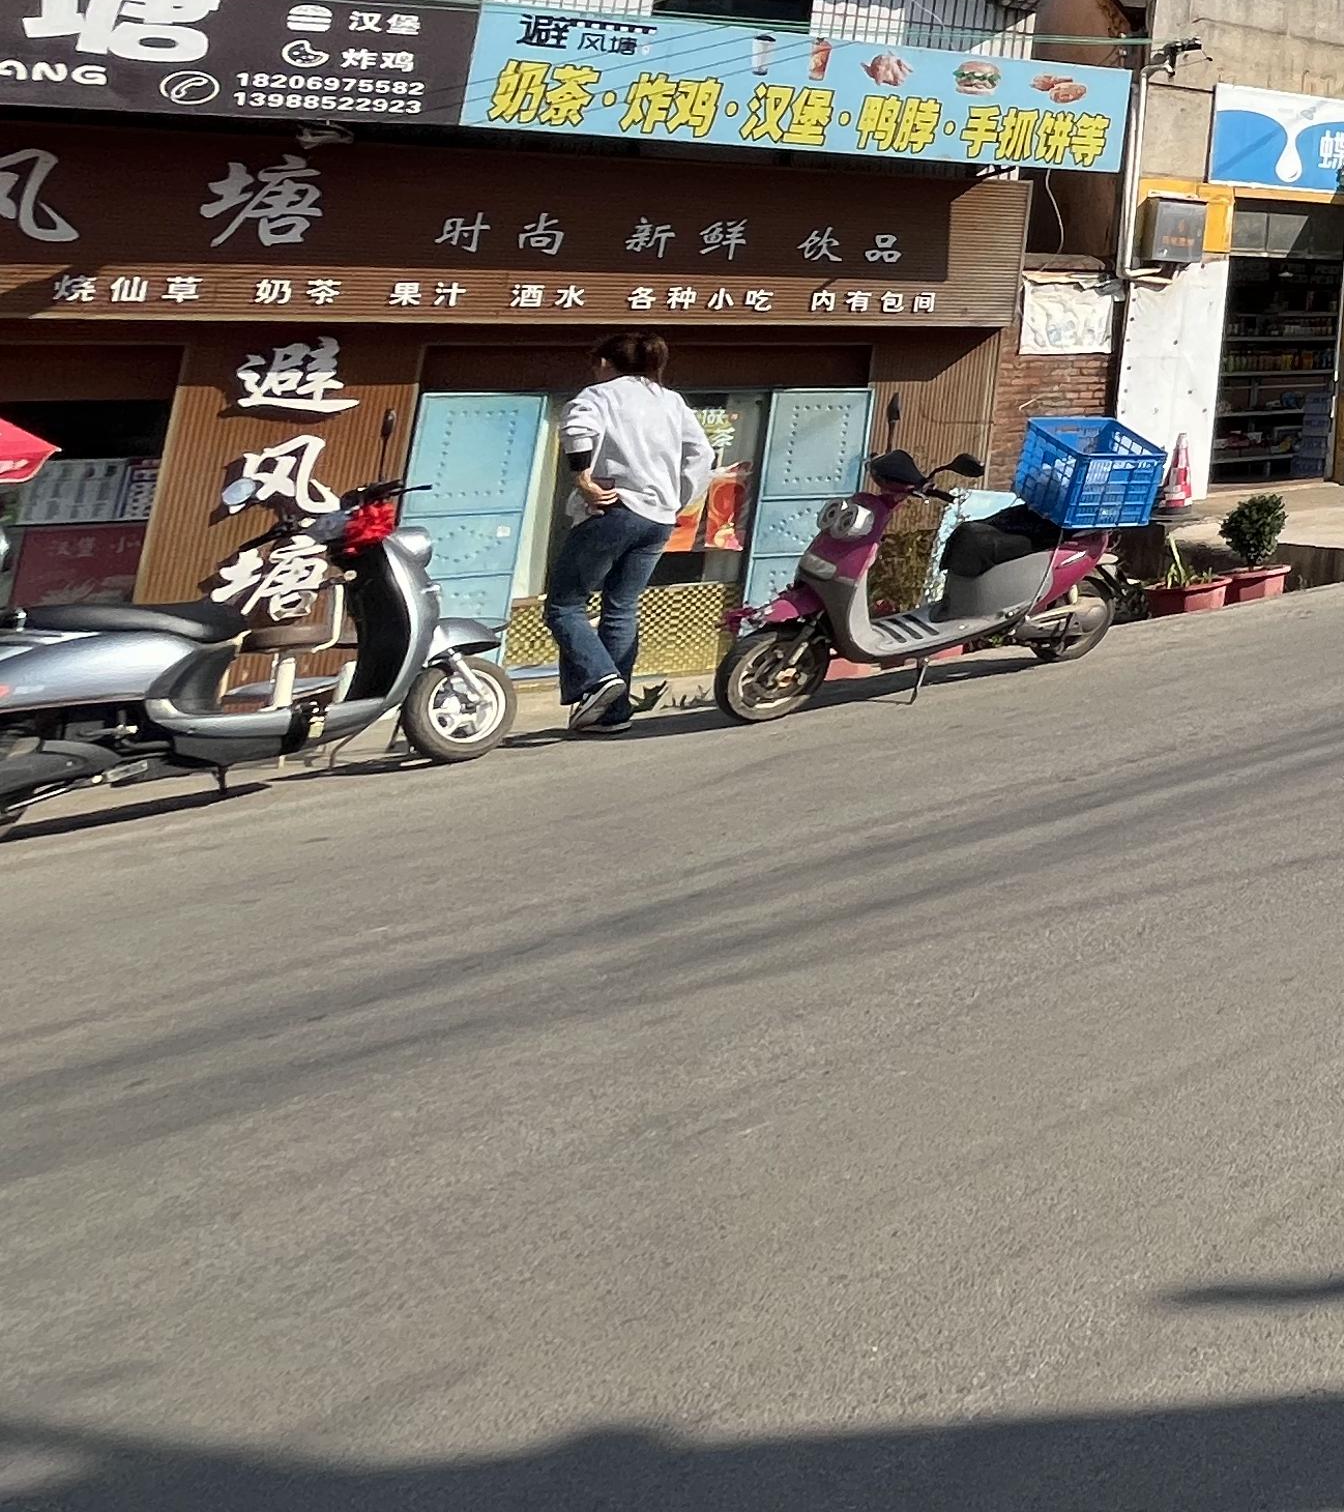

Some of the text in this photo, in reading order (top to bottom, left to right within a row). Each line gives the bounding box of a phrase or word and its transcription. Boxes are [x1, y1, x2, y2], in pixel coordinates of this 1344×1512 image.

[348, 11, 421, 37] 汉堡
[515, 13, 658, 57] 避风塘
[340, 48, 415, 73] 炸鸡
[236, 72, 425, 97] 18206975582
[233, 92, 422, 115] 13988522923
[434, 211, 565, 256] 时尚
[625, 215, 748, 261] 新鲜
[798, 228, 904, 265] 饮品
[53, 276, 937, 315] 烧仙草 奶茶 果汁 酒水 各种小吃 内有包间
[210, 336, 360, 622] 避风塘
